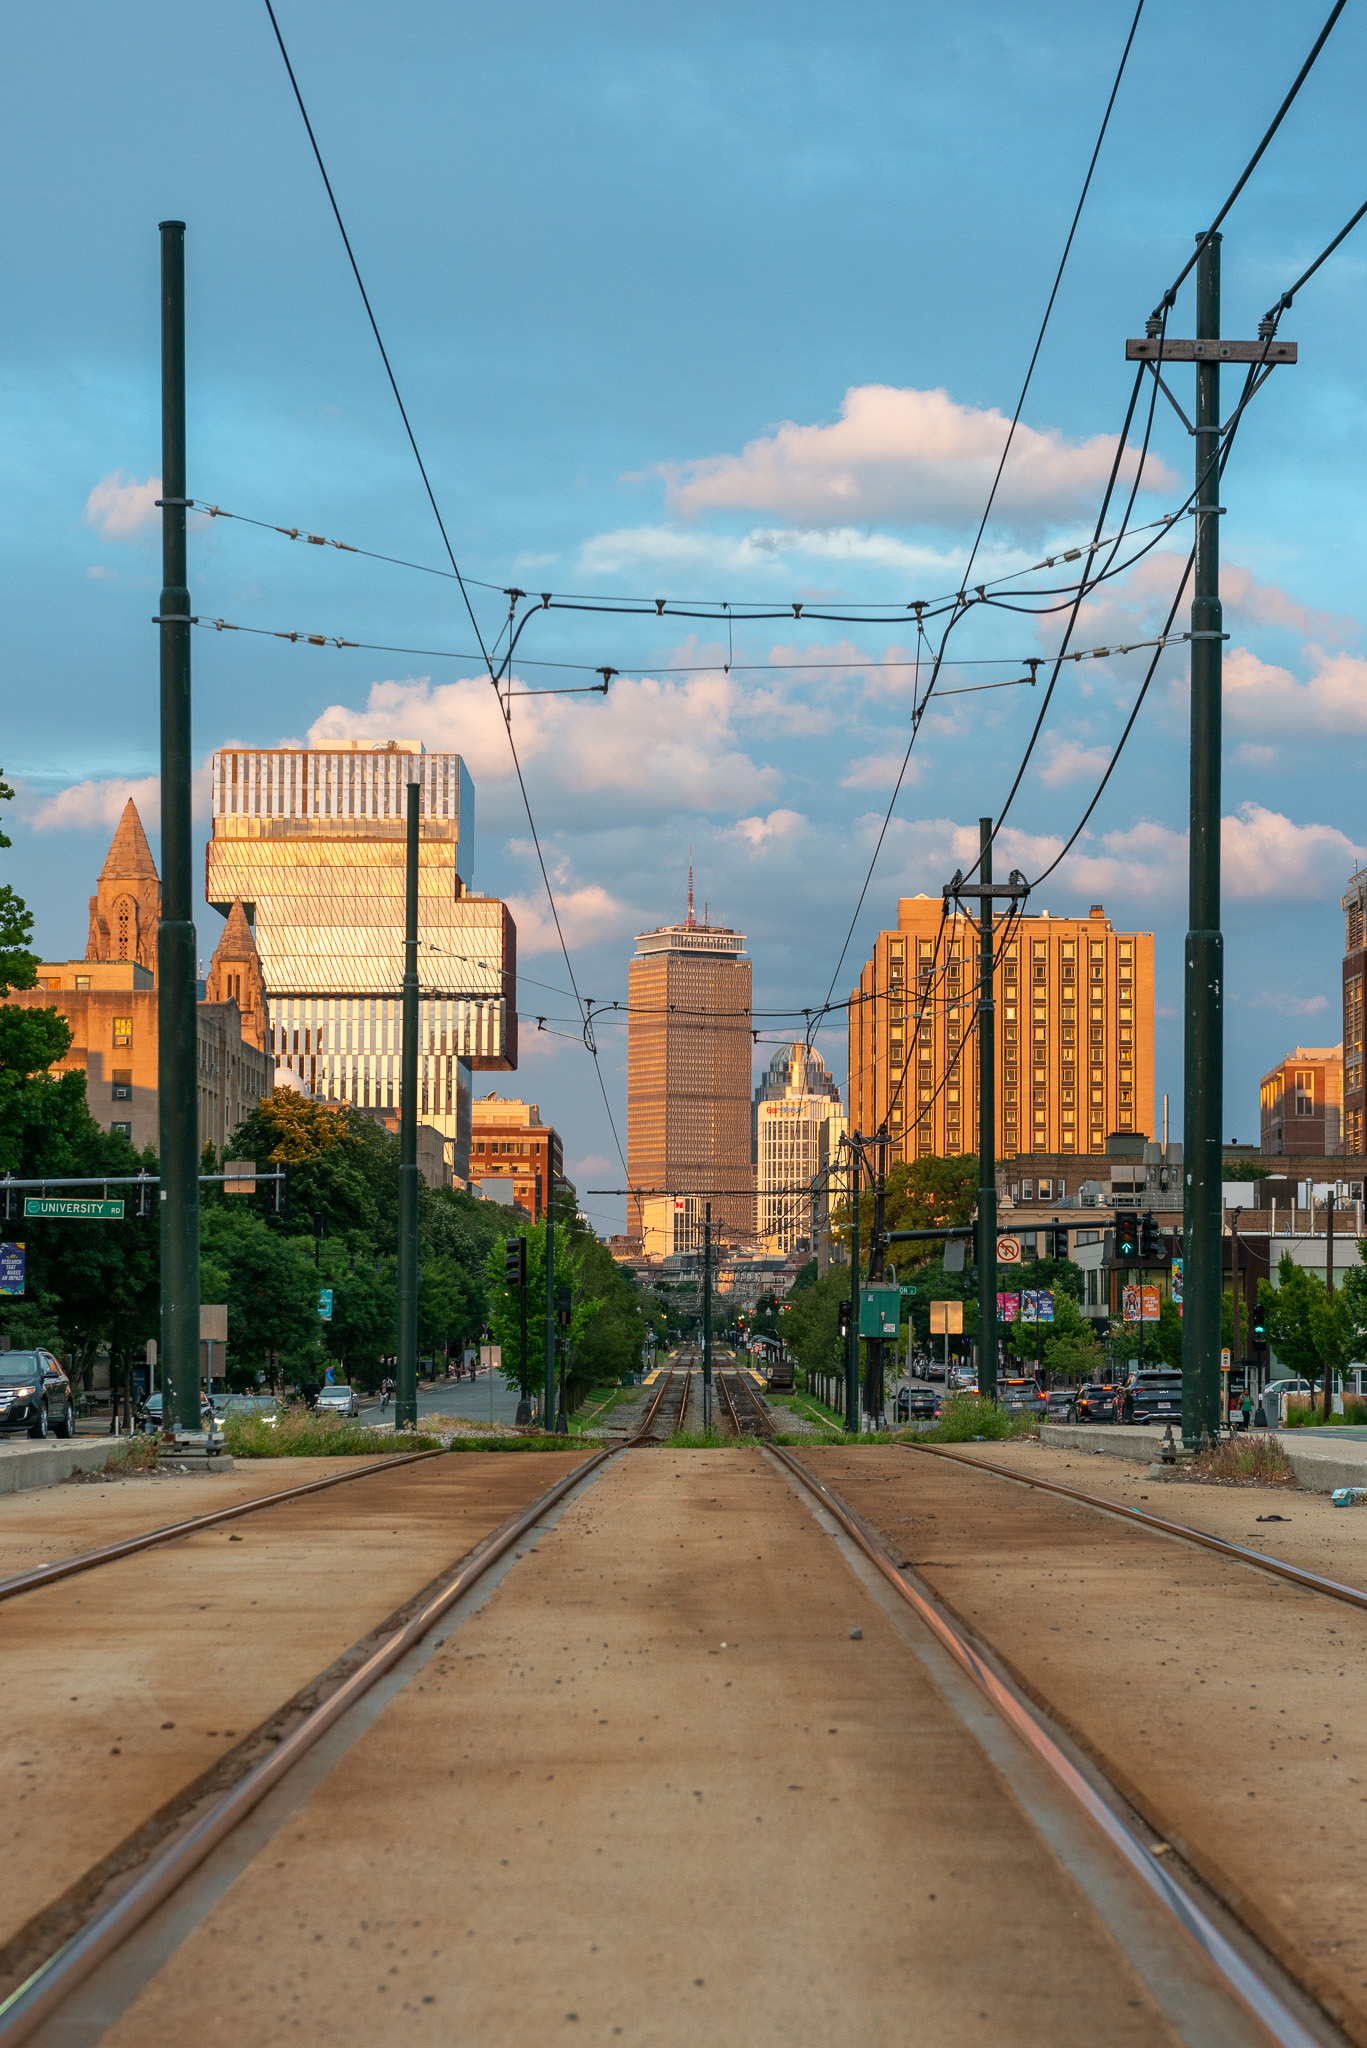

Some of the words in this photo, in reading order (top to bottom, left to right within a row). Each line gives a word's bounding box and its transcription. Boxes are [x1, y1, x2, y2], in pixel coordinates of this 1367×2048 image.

[682, 936, 732, 944] PRUDENTIAL
[766, 1106, 803, 1114] CarGurus
[41, 1203, 104, 1214] UNIVERSITY
